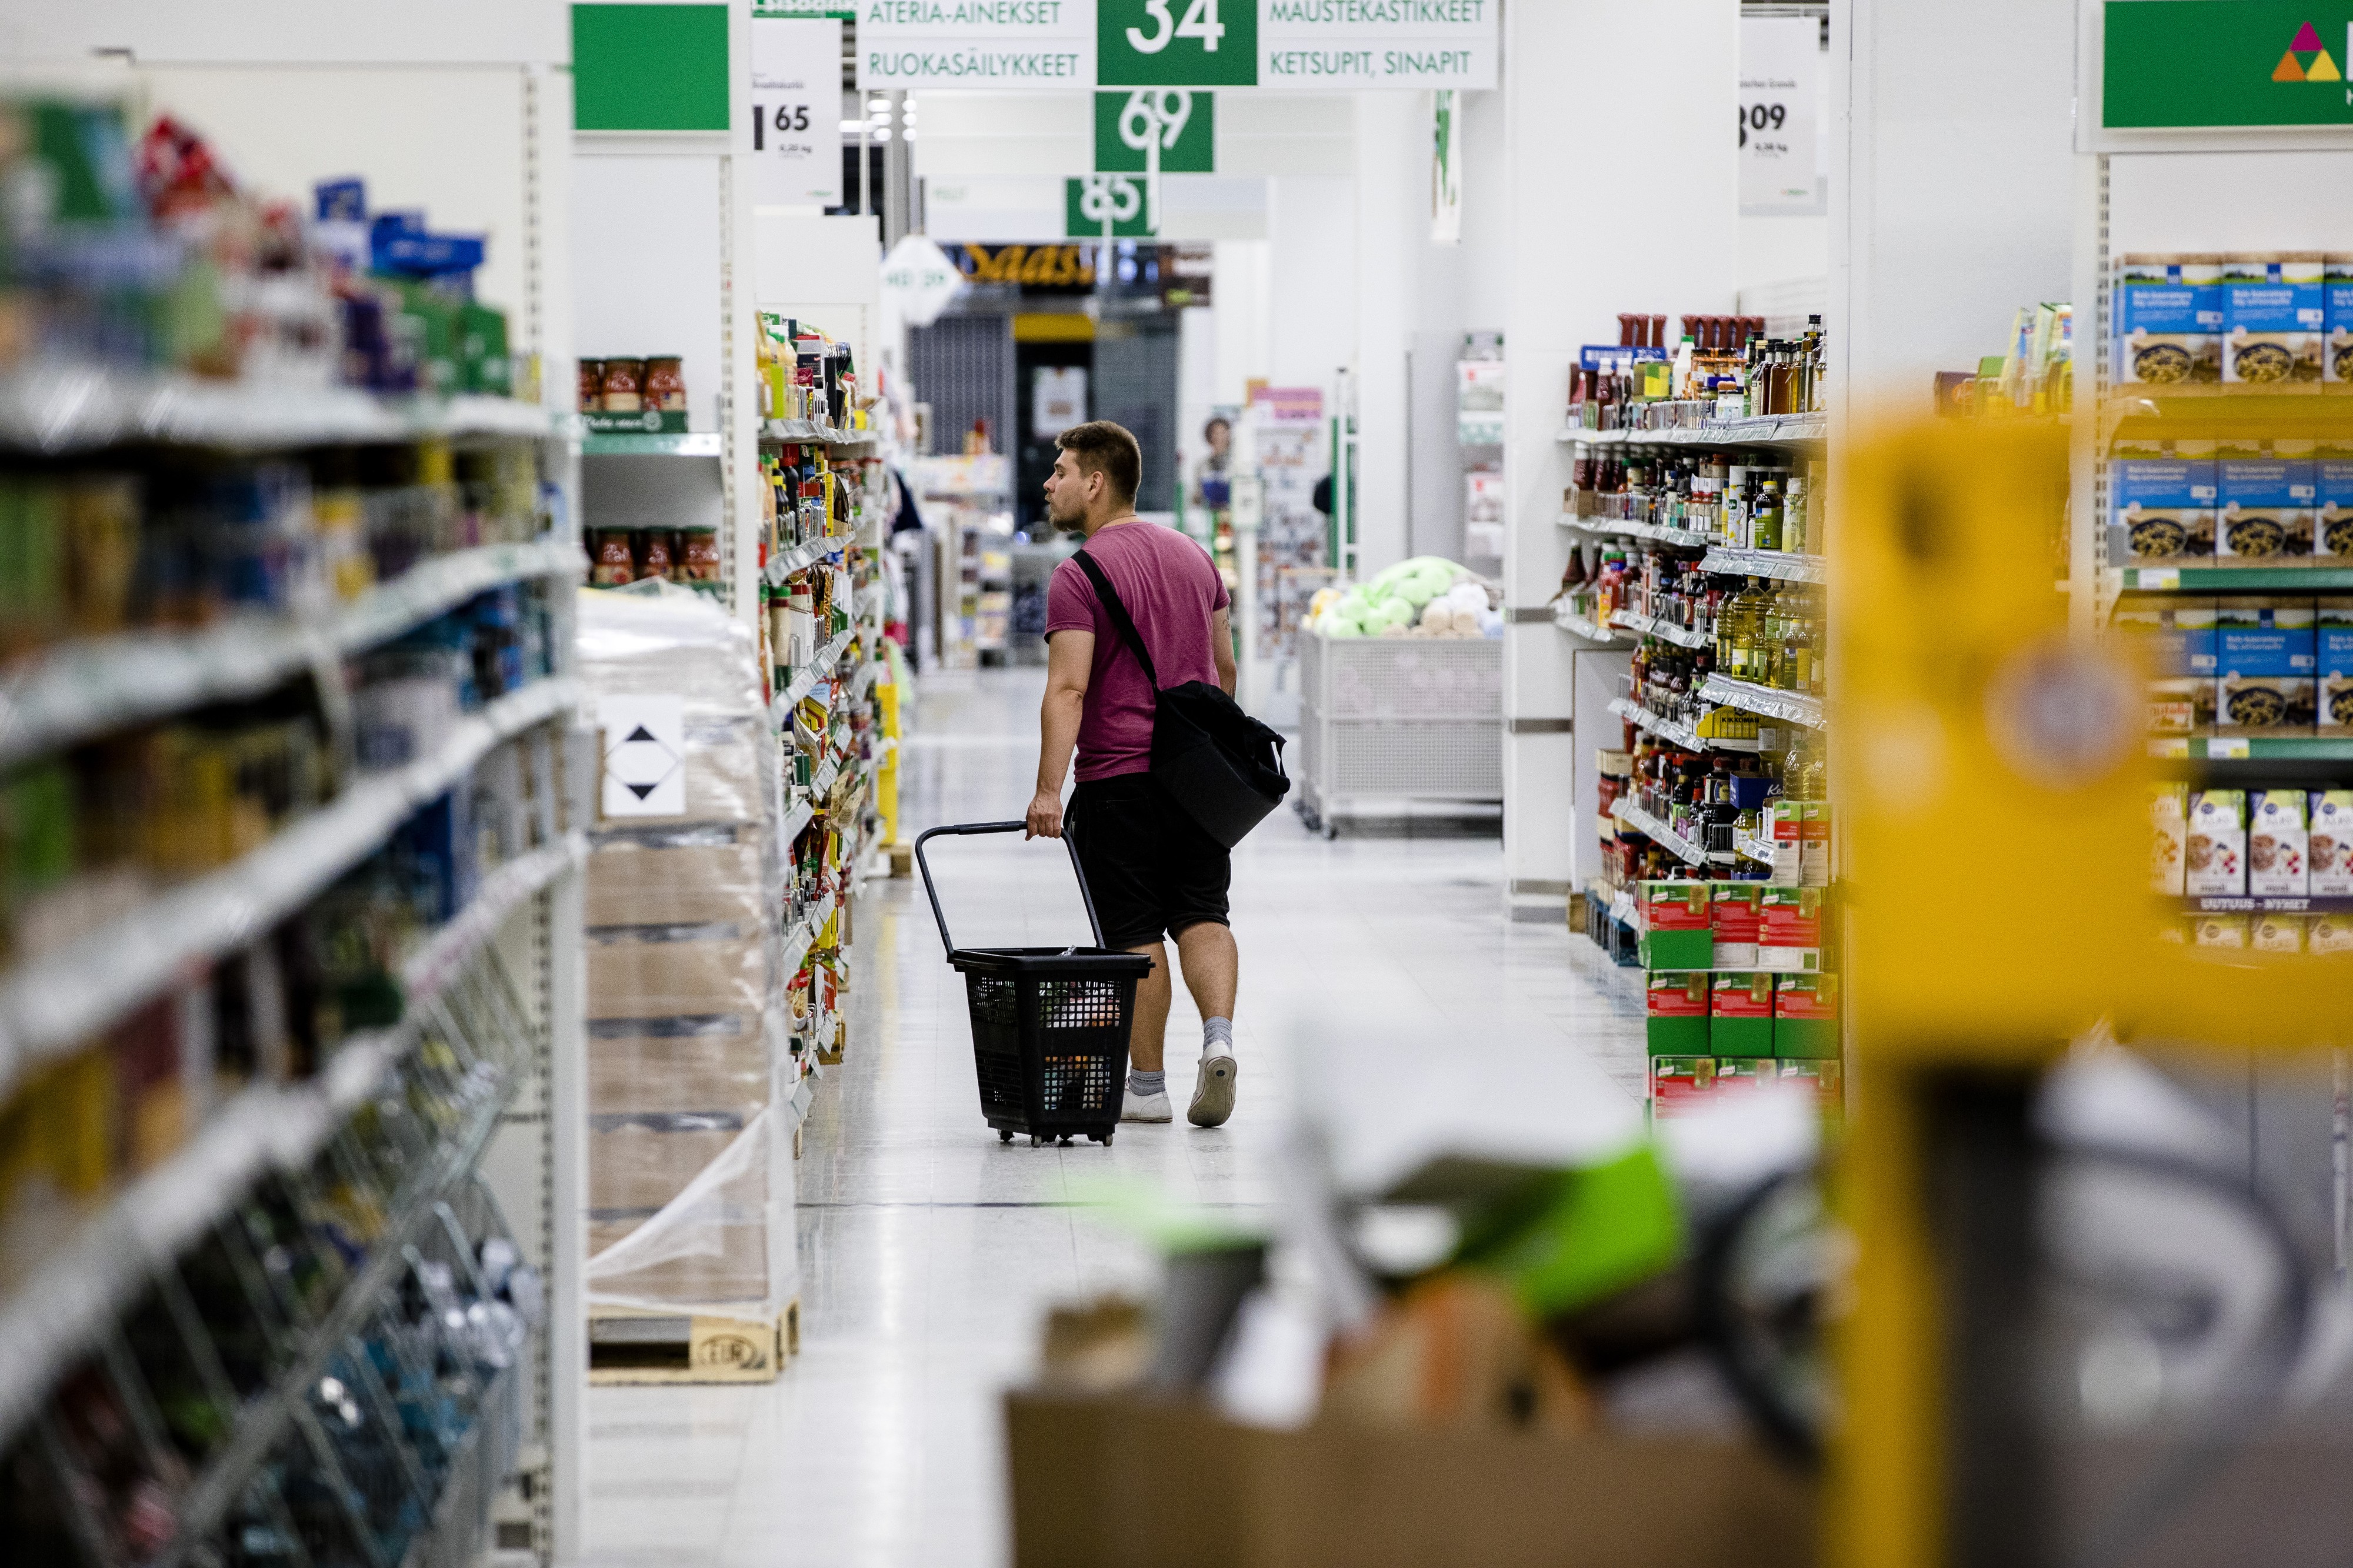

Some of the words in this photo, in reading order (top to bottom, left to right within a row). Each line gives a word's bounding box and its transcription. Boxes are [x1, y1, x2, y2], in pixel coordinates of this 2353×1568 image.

[868, 1, 1061, 24] ATERIA-AINEKSET
[1269, 0, 1484, 22] MAUSTEKASTIKKEET
[1126, 0, 1225, 54] 34
[868, 47, 1079, 77] RUOKASÄILYKKEET
[1270, 51, 1376, 79] KETSUPIT,
[1384, 51, 1472, 75] SINAPIT
[775, 104, 810, 131] 65
[1119, 91, 1193, 151] 69
[1080, 178, 1141, 222] 85
